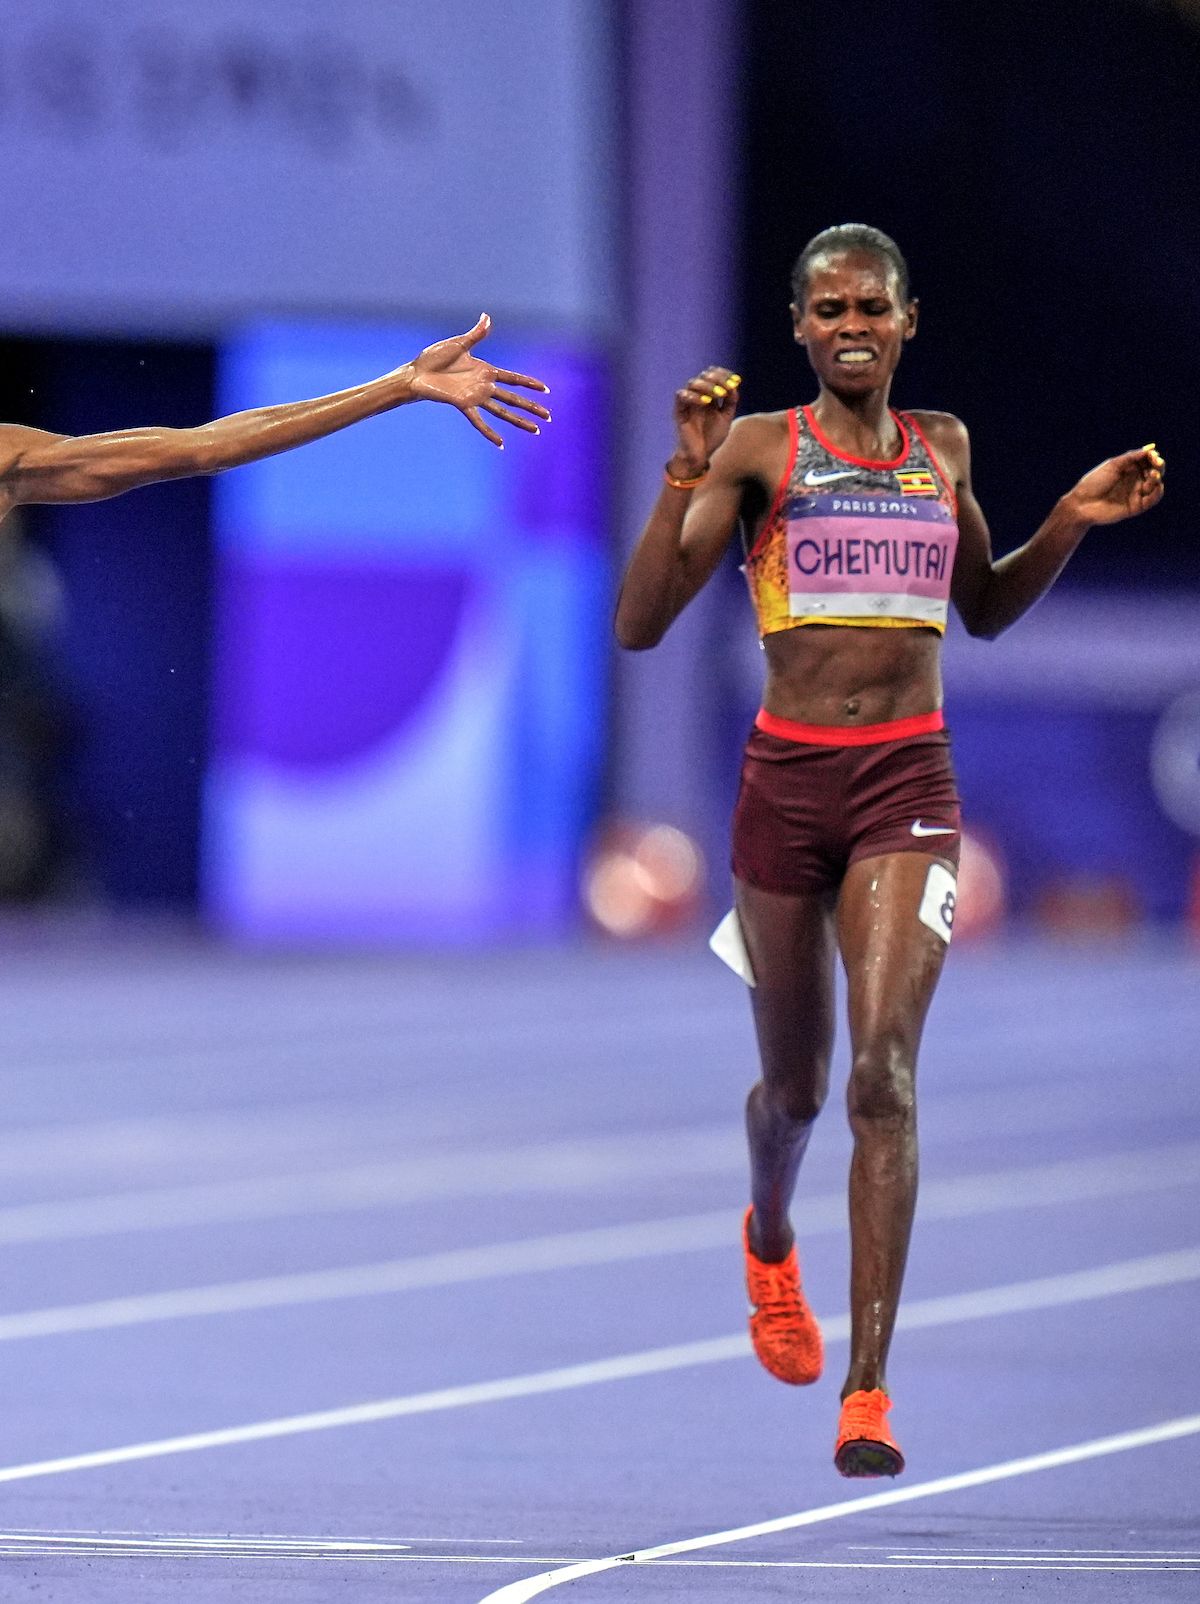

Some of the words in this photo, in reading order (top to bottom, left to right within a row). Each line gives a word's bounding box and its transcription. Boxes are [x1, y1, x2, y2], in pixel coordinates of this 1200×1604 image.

[832, 499, 877, 513] PARIS
[880, 501, 918, 514] 2024
[794, 539, 948, 581] CHEMUTAI
